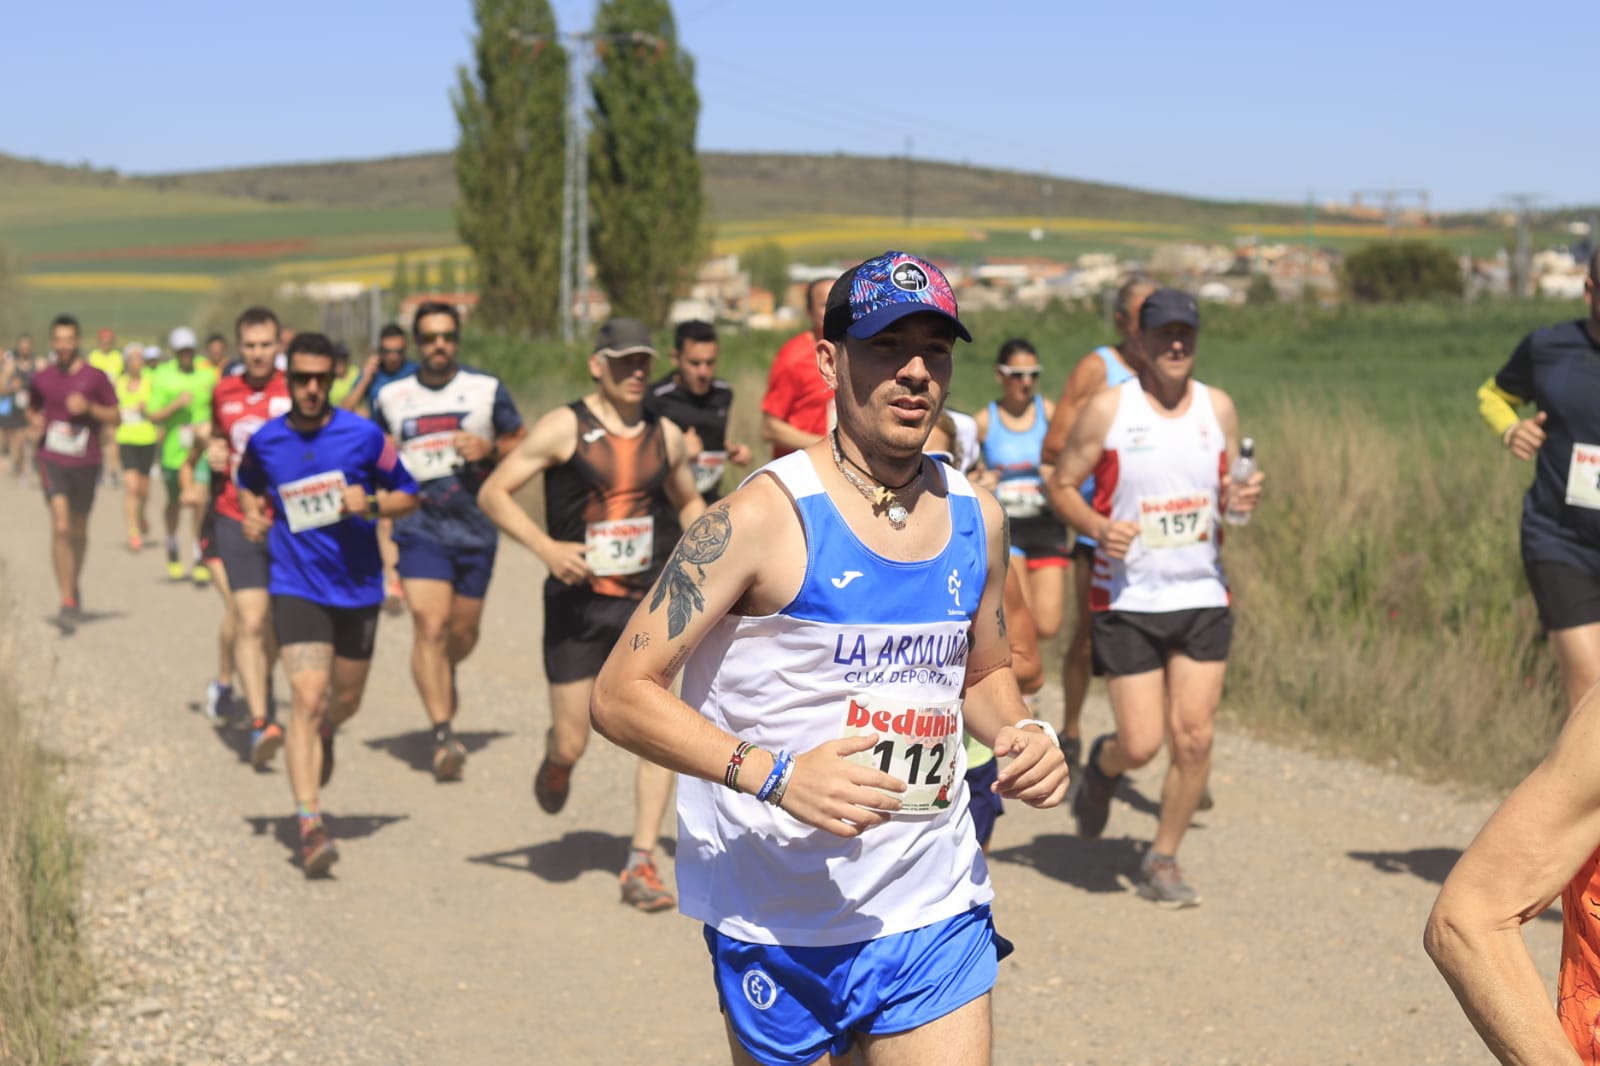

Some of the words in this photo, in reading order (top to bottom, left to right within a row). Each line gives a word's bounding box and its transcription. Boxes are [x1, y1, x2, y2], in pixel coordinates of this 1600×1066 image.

[301, 494, 336, 514] 121
[1159, 512, 1198, 535] 157
[610, 539, 635, 559] 36
[833, 634, 866, 666] LA
[844, 671, 883, 683] CLUB
[873, 740, 945, 785] 112
